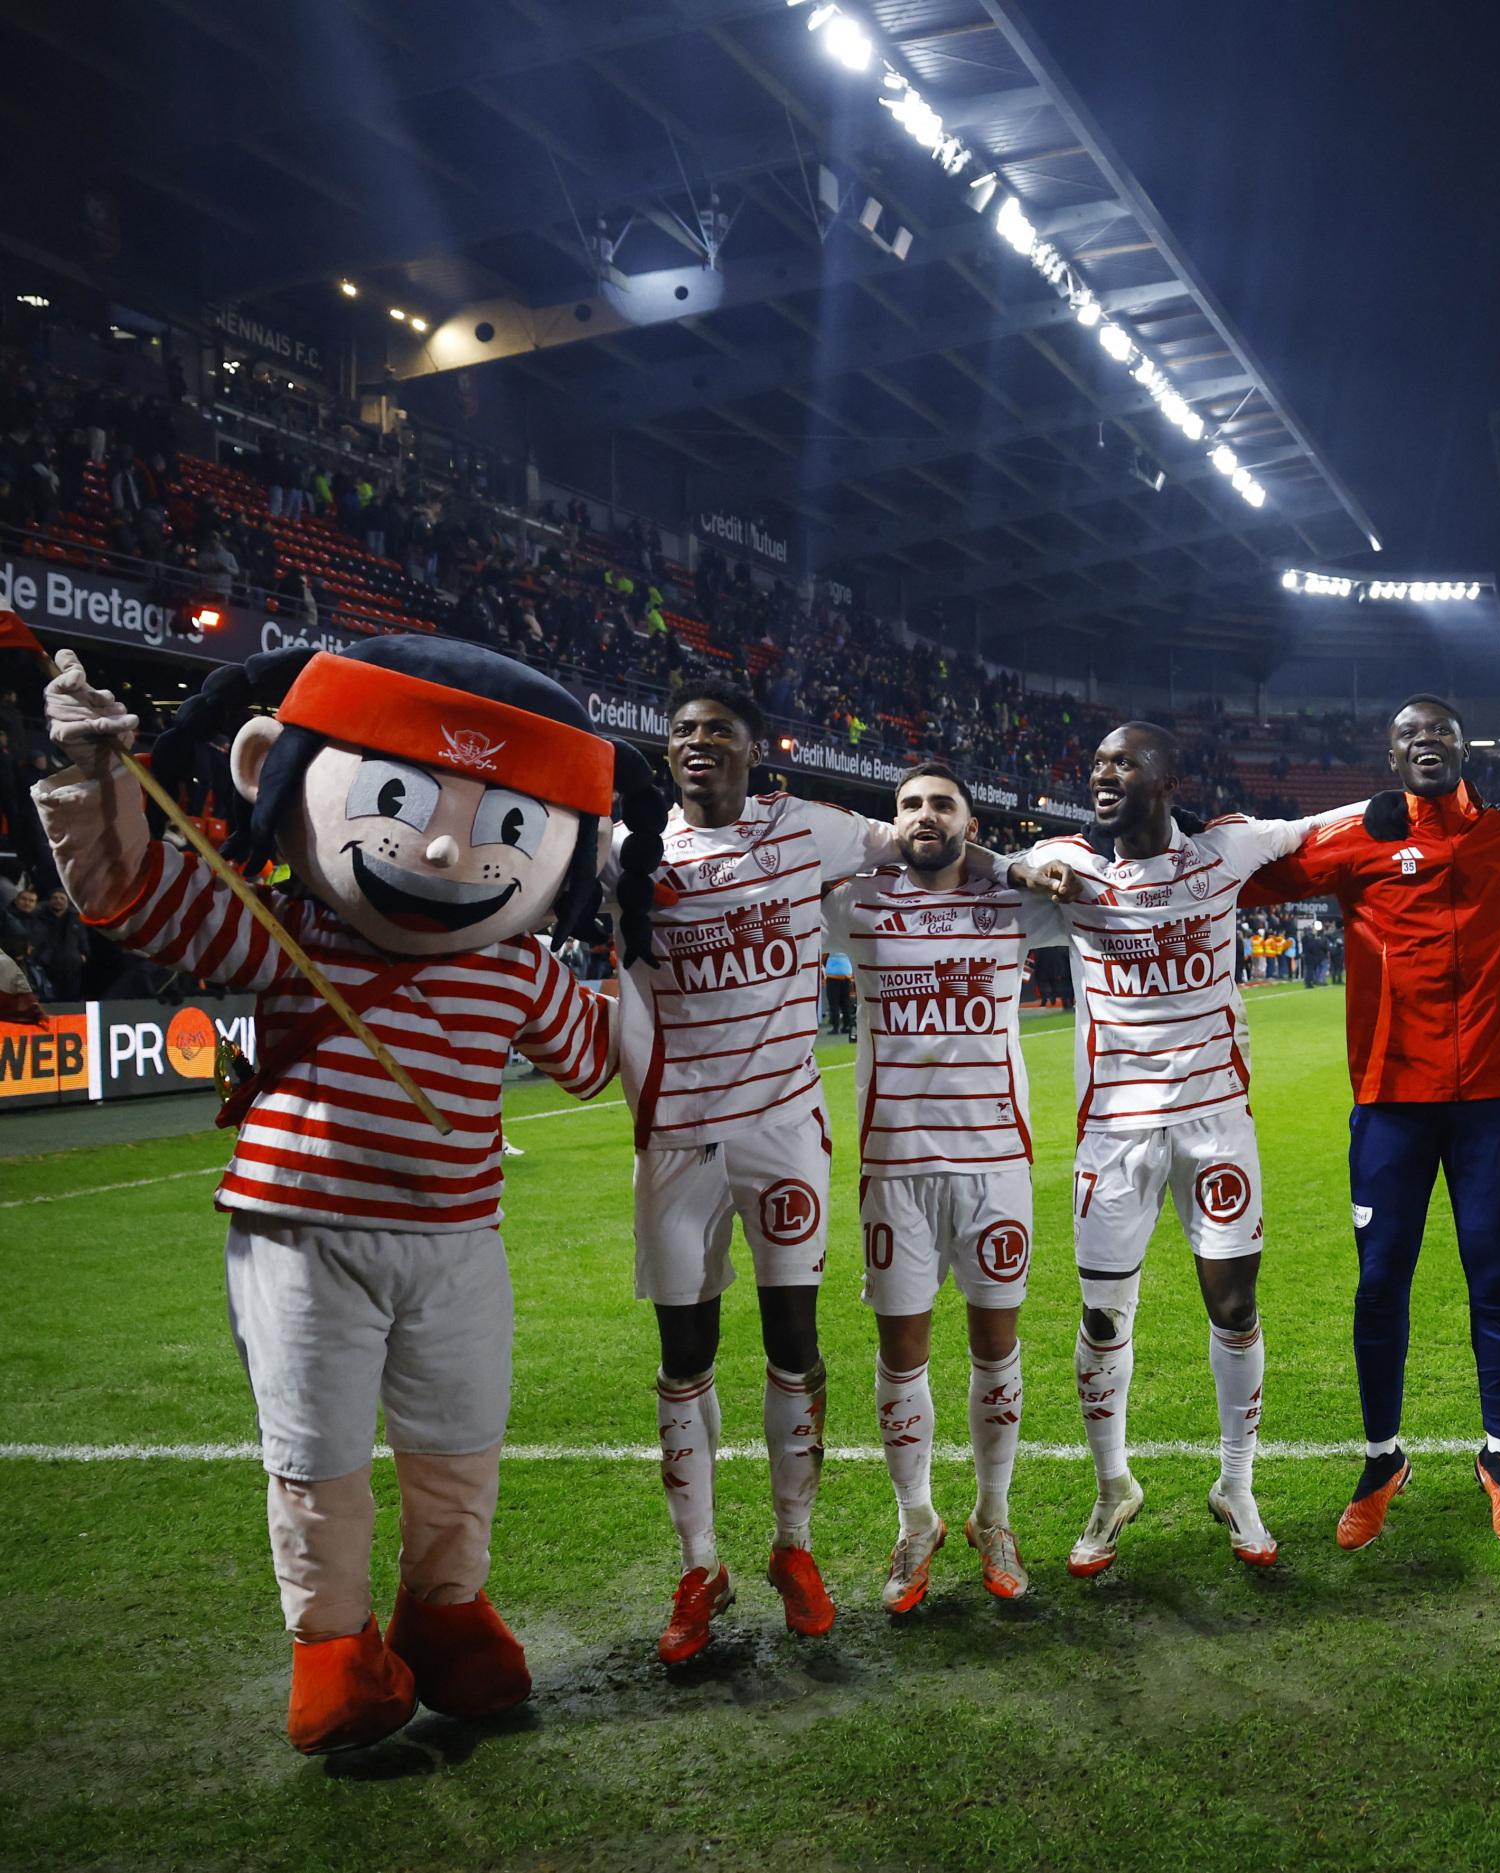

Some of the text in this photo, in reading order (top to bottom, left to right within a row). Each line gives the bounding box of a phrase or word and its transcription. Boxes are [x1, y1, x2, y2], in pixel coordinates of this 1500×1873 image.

[588, 692, 670, 737] Crédit Mut
[790, 738, 824, 770] Crédit
[825, 750, 859, 776] Mutuel
[860, 762, 872, 779] de
[873, 758, 906, 784] Bretag
[1403, 862, 1415, 872] 35
[709, 871, 736, 888] Cola
[1136, 885, 1173, 907] Breizh
[919, 908, 958, 926] Breizh
[667, 925, 725, 946] YAOURT
[927, 923, 953, 935] Cola
[1100, 938, 1151, 953] YAOURT
[681, 939, 793, 992] MALO
[1111, 952, 1211, 995] MALO
[880, 973, 932, 988] YAOURT
[889, 996, 993, 1033] MALO
[0, 1032, 84, 1081] WEB
[1074, 1170, 1099, 1218] 17
[863, 1222, 894, 1270] 10
[665, 1448, 694, 1462] SP
